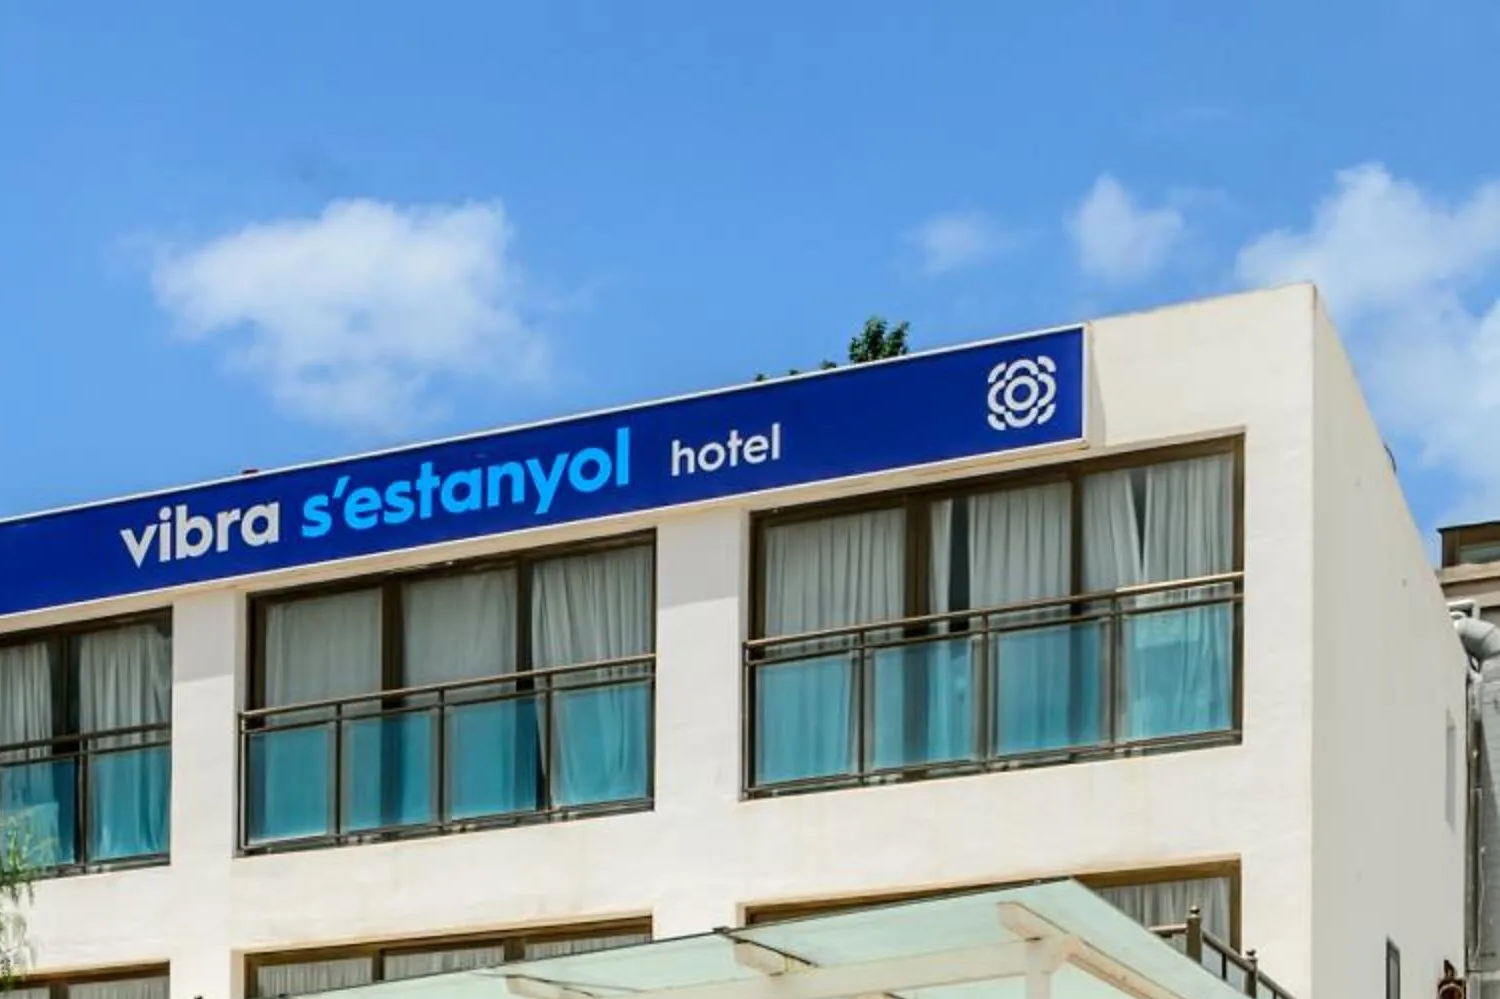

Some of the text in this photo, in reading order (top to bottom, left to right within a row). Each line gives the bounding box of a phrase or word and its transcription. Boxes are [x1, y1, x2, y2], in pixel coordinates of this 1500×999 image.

[120, 422, 780, 568] vibra s'estanyol hotel
